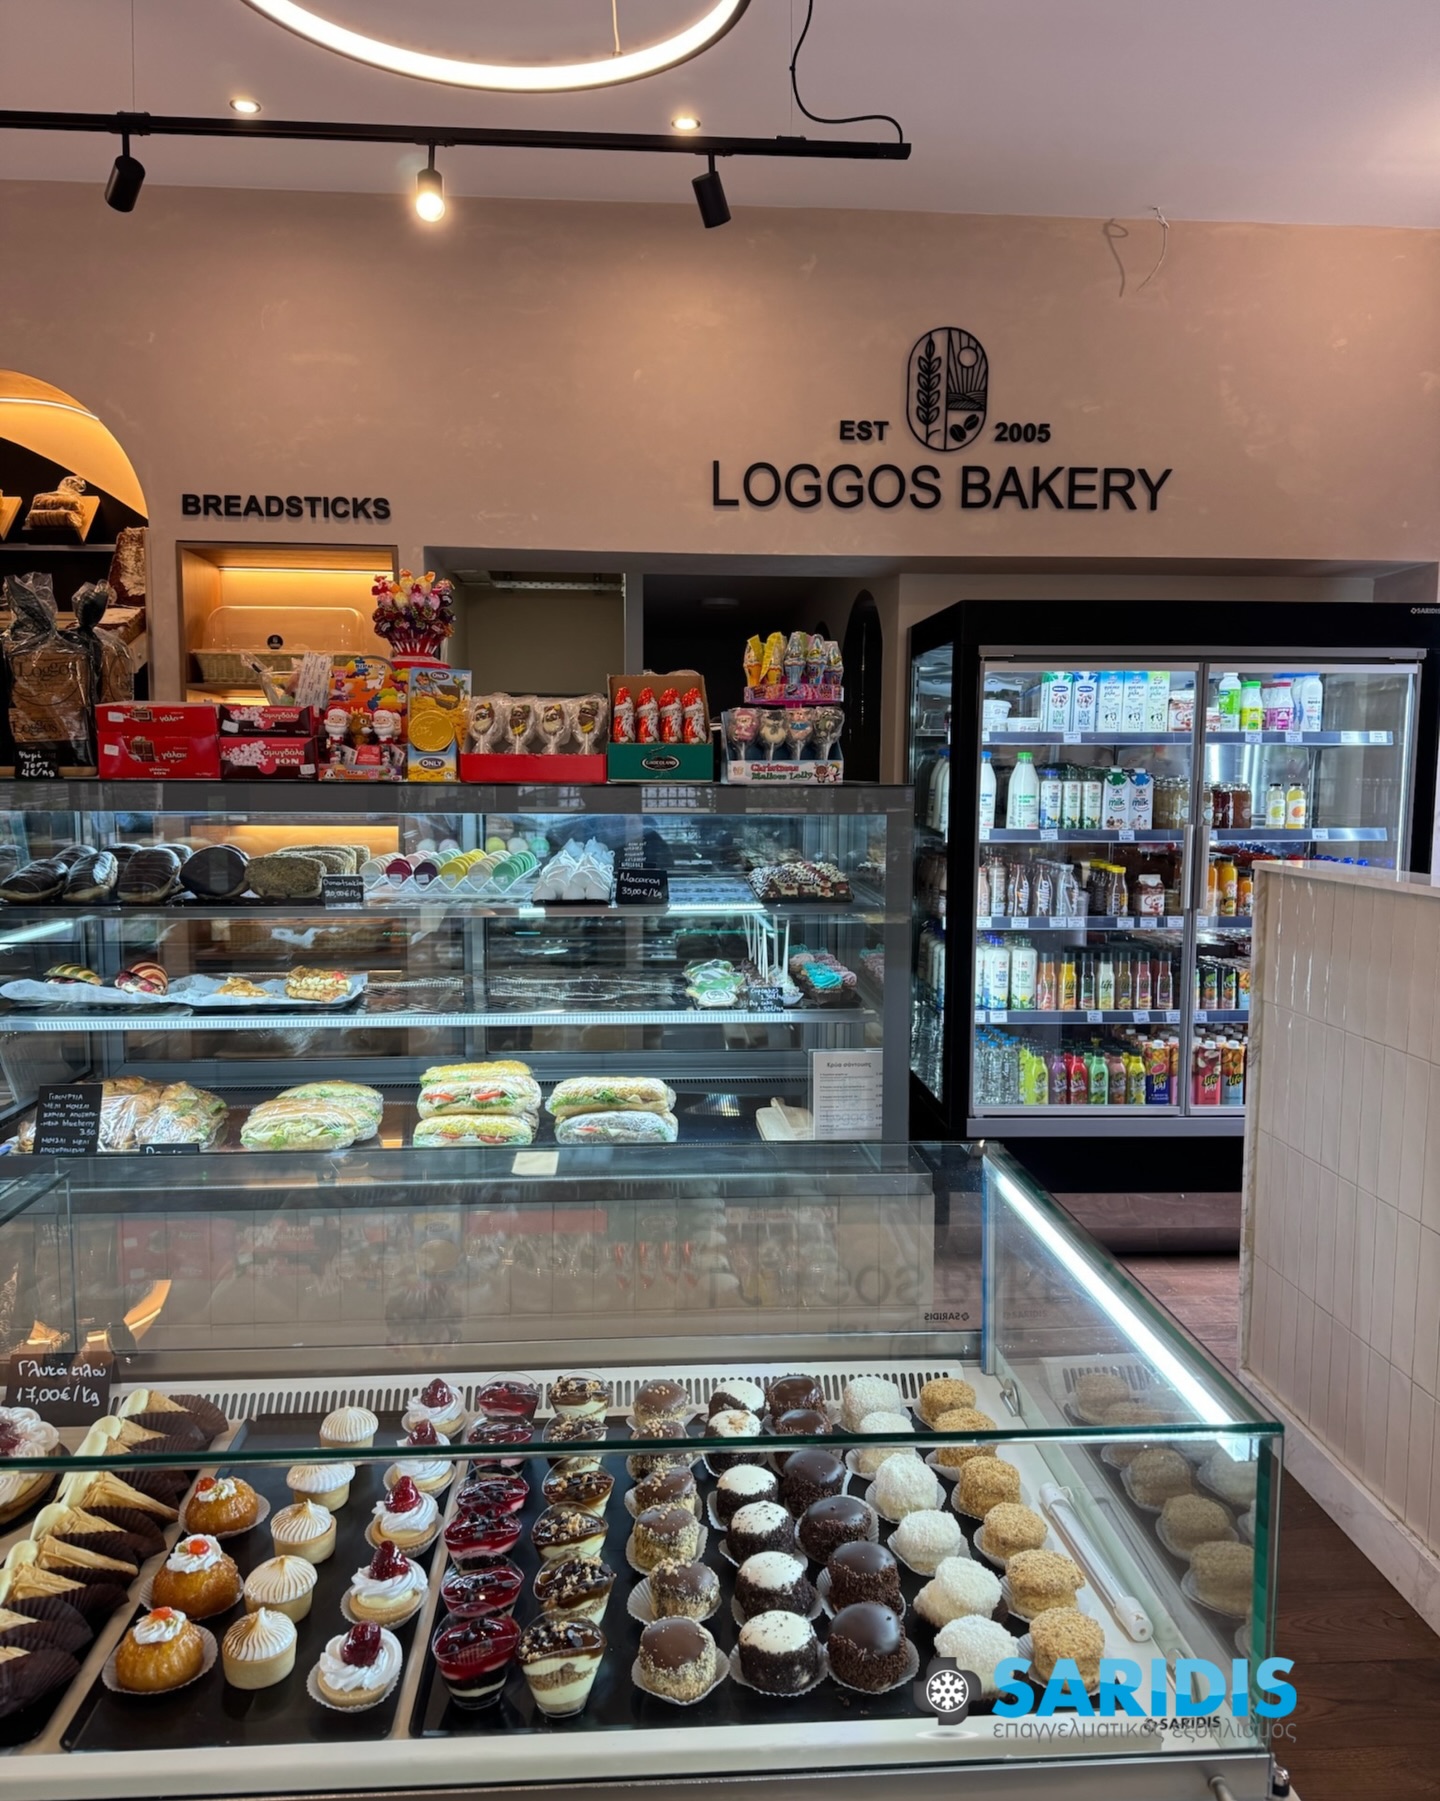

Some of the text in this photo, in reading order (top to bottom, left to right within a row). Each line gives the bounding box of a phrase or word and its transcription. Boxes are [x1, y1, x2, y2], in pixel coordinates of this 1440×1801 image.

[839, 419, 1051, 443] EST 2005
[712, 460, 1173, 511] LOGGOS BAKERY
[181, 494, 391, 520] BREADSTICKS
[432, 670, 449, 680] ONLY
[422, 760, 442, 768] ONLY
